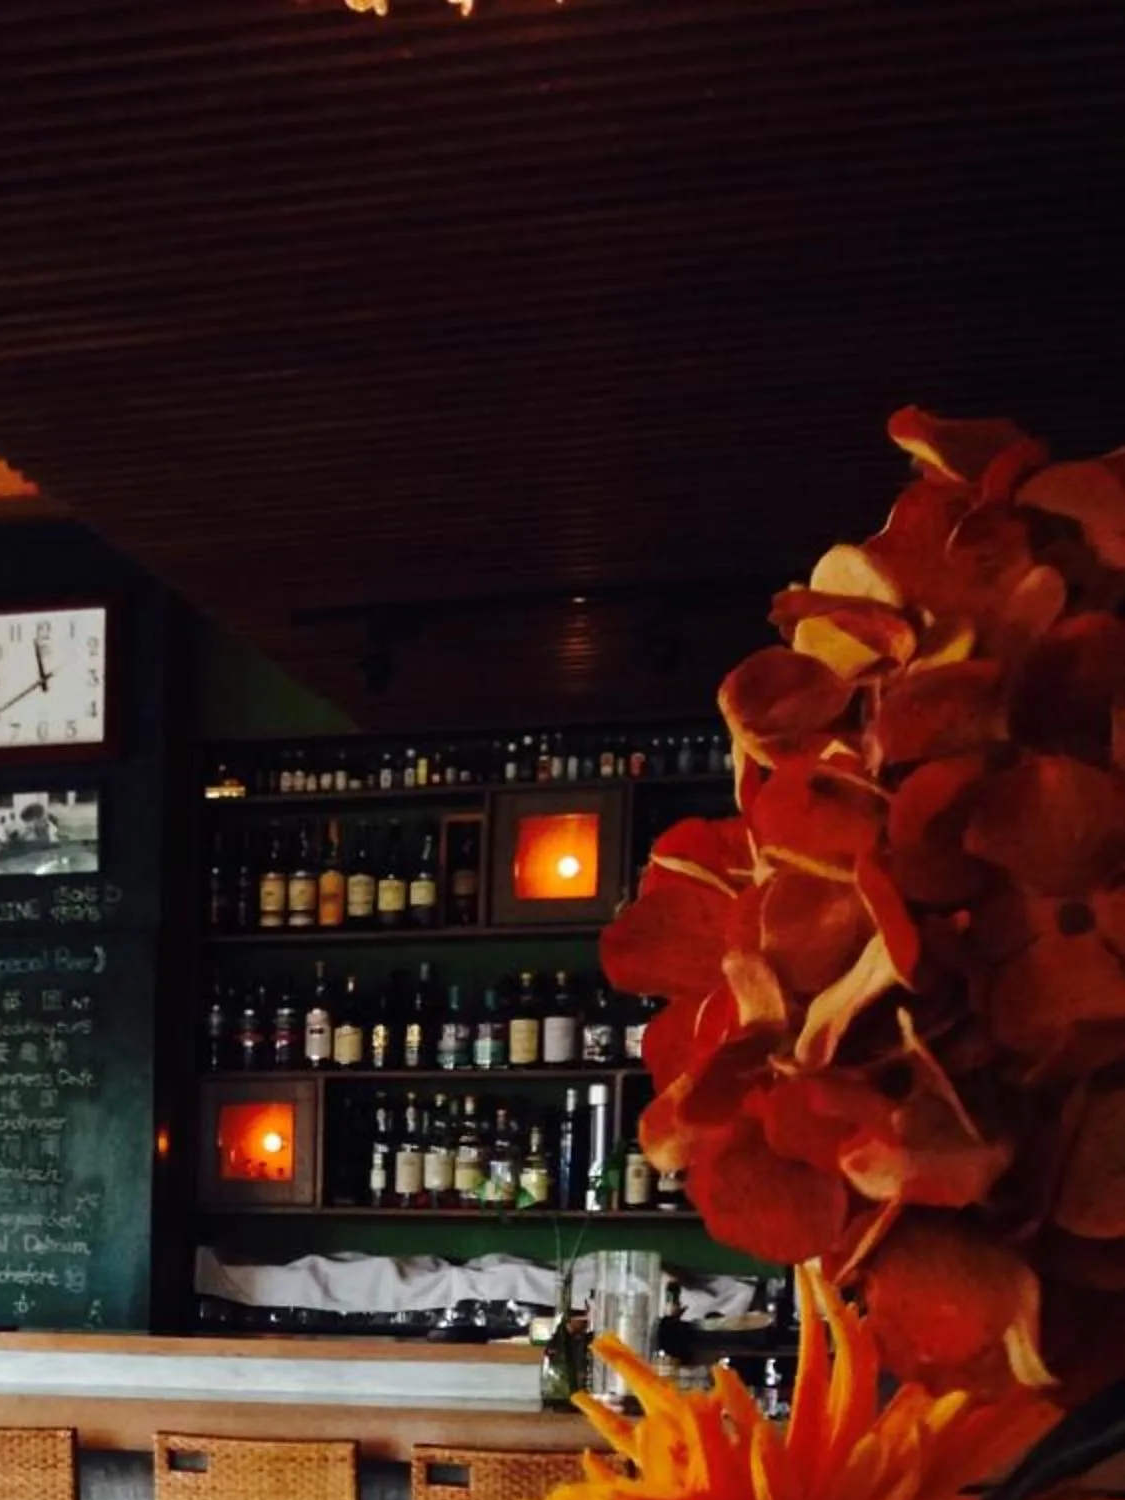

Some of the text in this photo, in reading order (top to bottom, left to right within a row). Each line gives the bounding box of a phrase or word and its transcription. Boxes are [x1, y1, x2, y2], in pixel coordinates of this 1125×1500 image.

[9, 624, 22, 643] 11
[36, 620, 52, 640] 12
[86, 636, 99, 656] 2
[87, 669, 100, 688] 3
[9, 722, 21, 742] 7
[66, 720, 77, 738] 5
